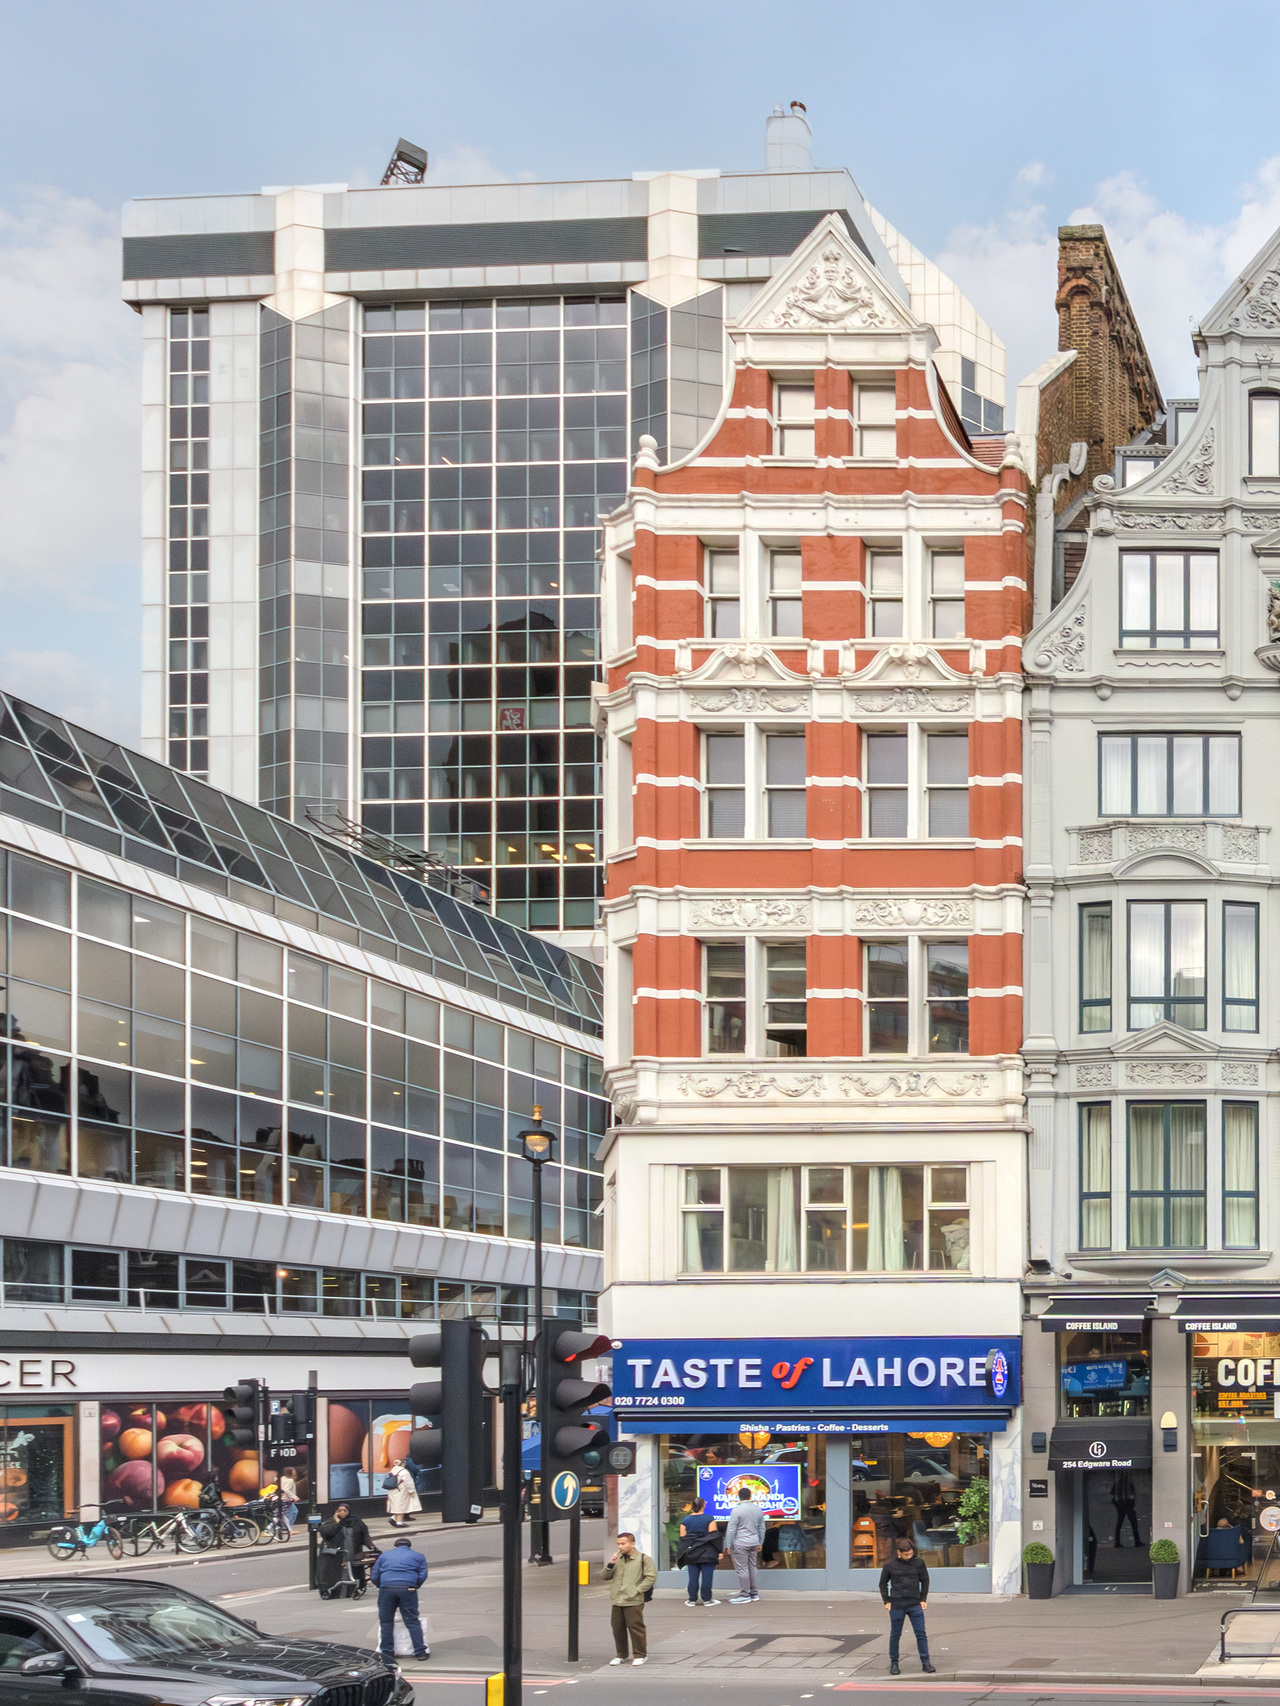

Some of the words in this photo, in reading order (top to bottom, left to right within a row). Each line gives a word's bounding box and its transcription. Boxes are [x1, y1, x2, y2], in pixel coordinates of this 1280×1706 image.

[1066, 1322, 1091, 1330] COFFEE
[1092, 1322, 1118, 1330] ISLAND
[1185, 1322, 1211, 1330] COFFEE
[1212, 1322, 1237, 1330] ISLAND
[627, 1358, 763, 1389] TASTE
[772, 1356, 814, 1389] of
[822, 1357, 988, 1387] LAHORE
[614, 1396, 633, 1405] 020
[635, 1396, 659, 1405] 7724
[660, 1396, 685, 1405] 0300
[740, 1424, 770, 1432] Shisha
[776, 1424, 811, 1432] Pastries
[817, 1424, 845, 1432] Coffee
[852, 1424, 889, 1432] Desserts
[1077, 1460, 1110, 1469] Edgware
[1112, 1459, 1132, 1467] Road
